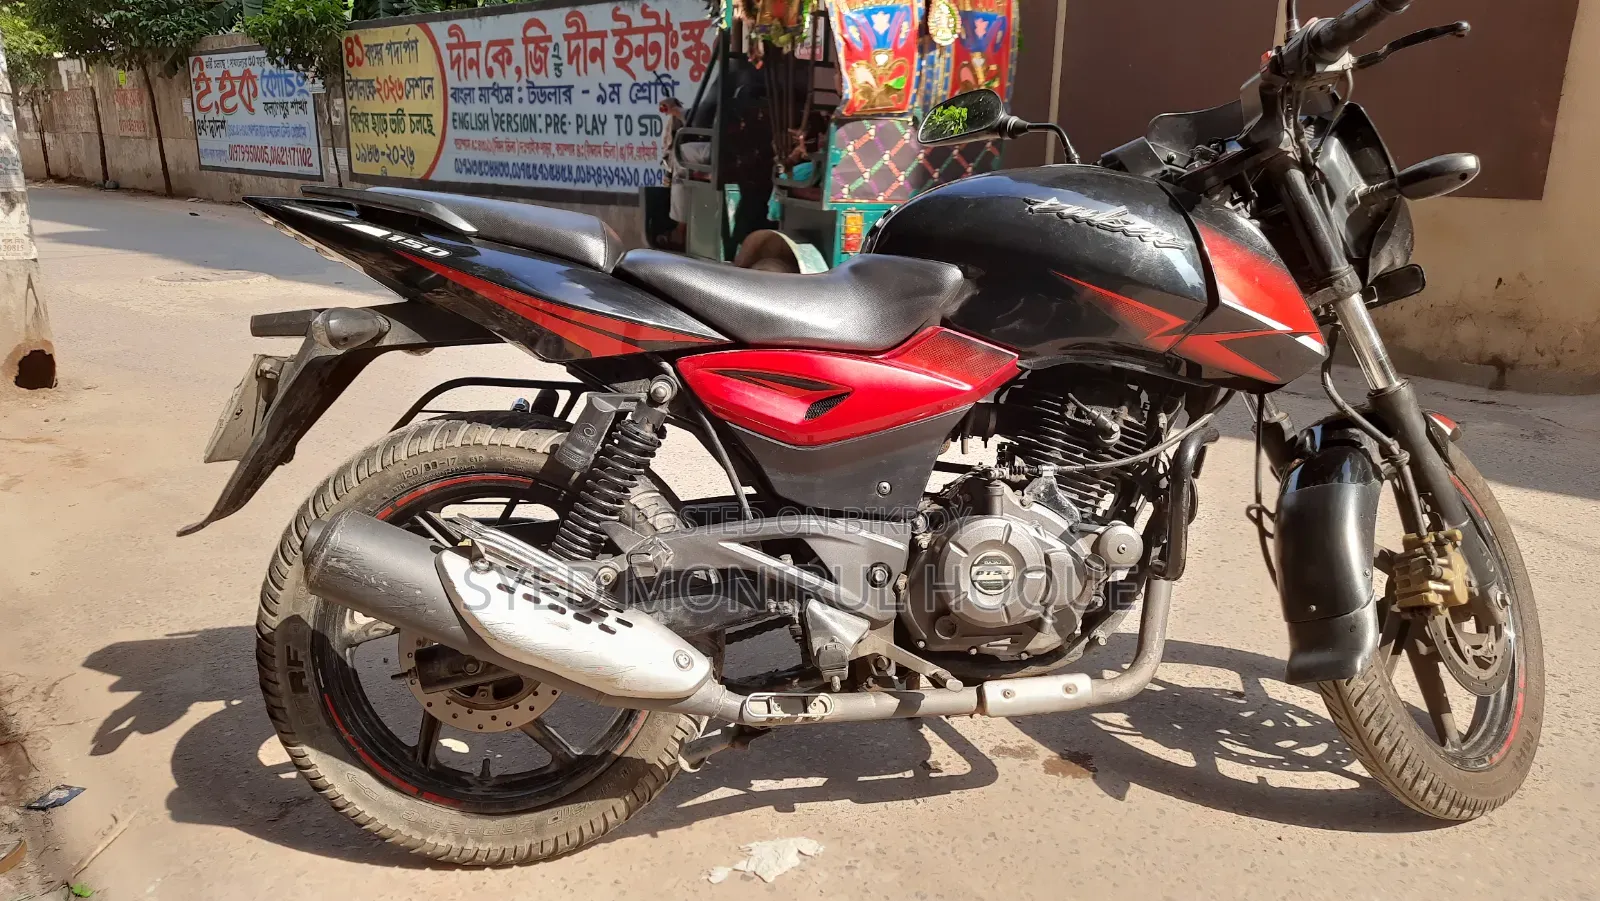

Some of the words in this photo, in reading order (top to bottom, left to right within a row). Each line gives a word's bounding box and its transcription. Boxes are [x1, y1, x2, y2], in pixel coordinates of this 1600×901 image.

[344, 33, 365, 69] ৪১
[446, 24, 482, 82] দীন
[562, 10, 608, 77] দীন
[450, 87, 475, 105] বাংলা
[478, 81, 514, 105] মাধ্যম
[452, 111, 489, 132] ENGLISH
[576, 113, 607, 136] PLAY
[614, 114, 633, 137] TO
[387, 234, 452, 258] 150
